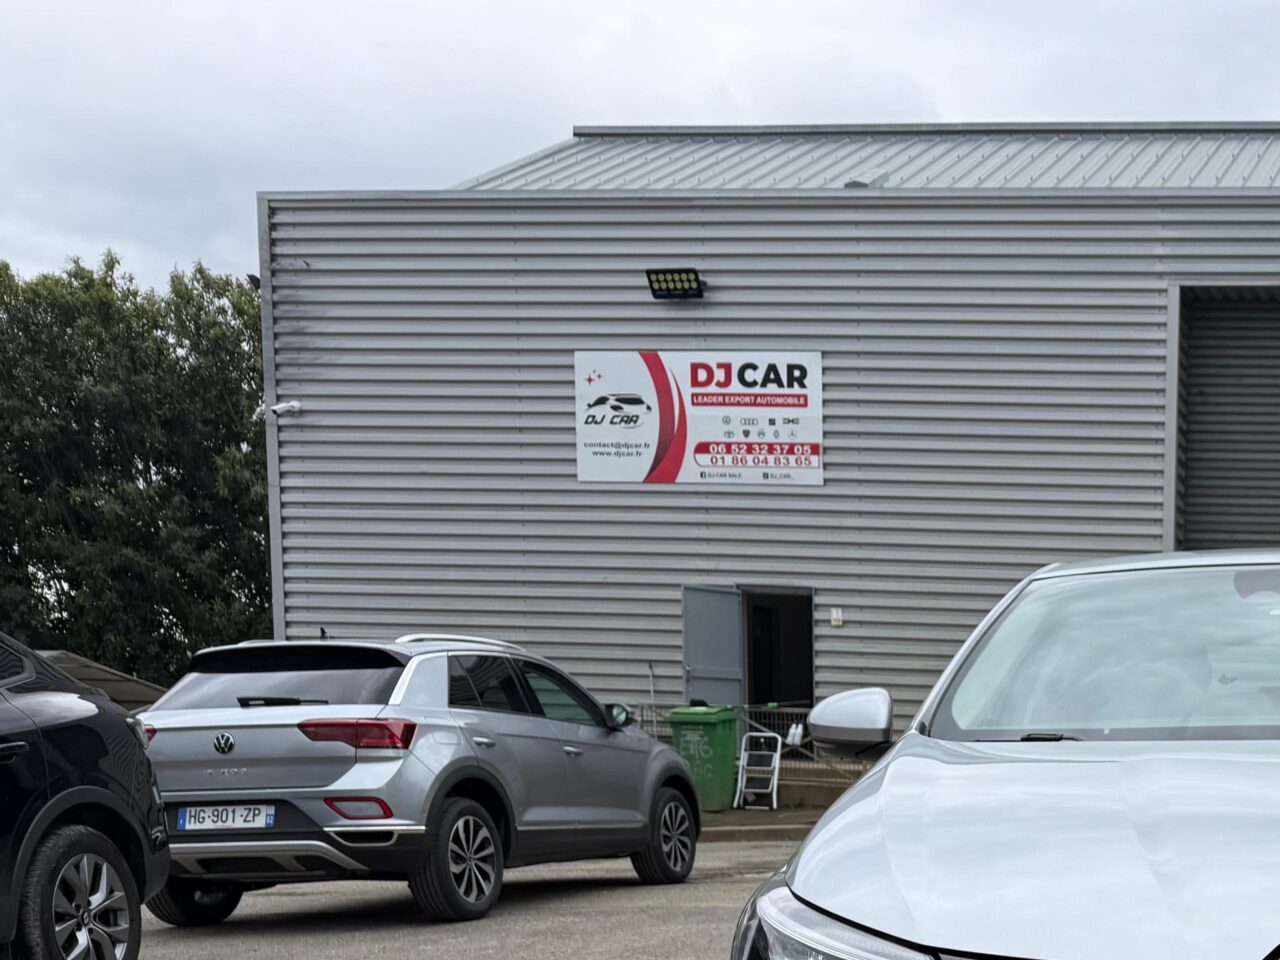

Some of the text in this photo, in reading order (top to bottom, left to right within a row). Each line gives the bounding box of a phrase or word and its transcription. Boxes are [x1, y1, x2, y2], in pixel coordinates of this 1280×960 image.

[690, 362, 807, 389] DJ CAR
[693, 394, 805, 405] LEADER EXPORT AUTOMOBILE
[584, 414, 640, 425] DJ CAR
[583, 441, 650, 450] contact@djcar.fr
[709, 444, 811, 455] 06 52 32 37 05
[592, 450, 642, 458] www.djcar.fr
[710, 455, 811, 466] 01 86 04 83 65
